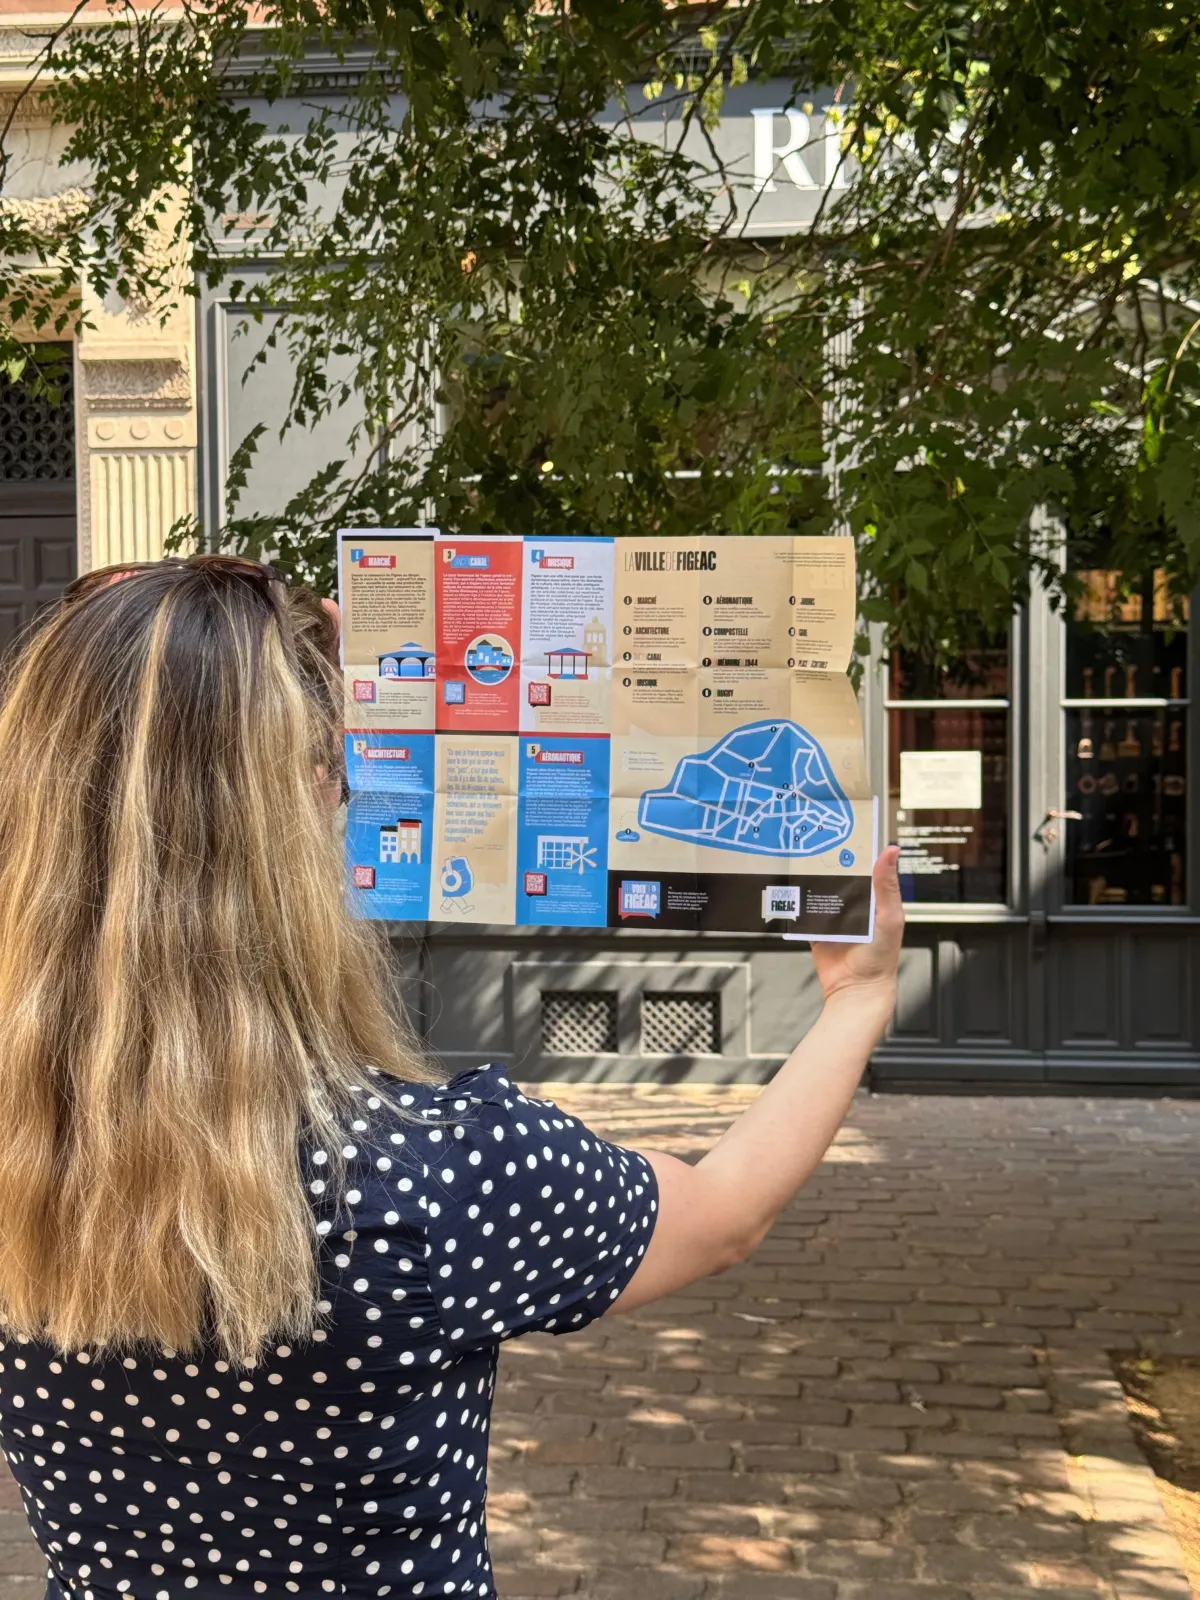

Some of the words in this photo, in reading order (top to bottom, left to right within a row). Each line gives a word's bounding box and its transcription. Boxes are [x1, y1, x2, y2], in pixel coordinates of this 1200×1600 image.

[713, 628, 748, 636] COMPOSTELLE
[744, 659, 758, 667] 1944
[541, 751, 582, 763] AÉRONAUTIQUE
[624, 893, 657, 909] FIGEAC
[771, 900, 796, 912] FIGEAC
